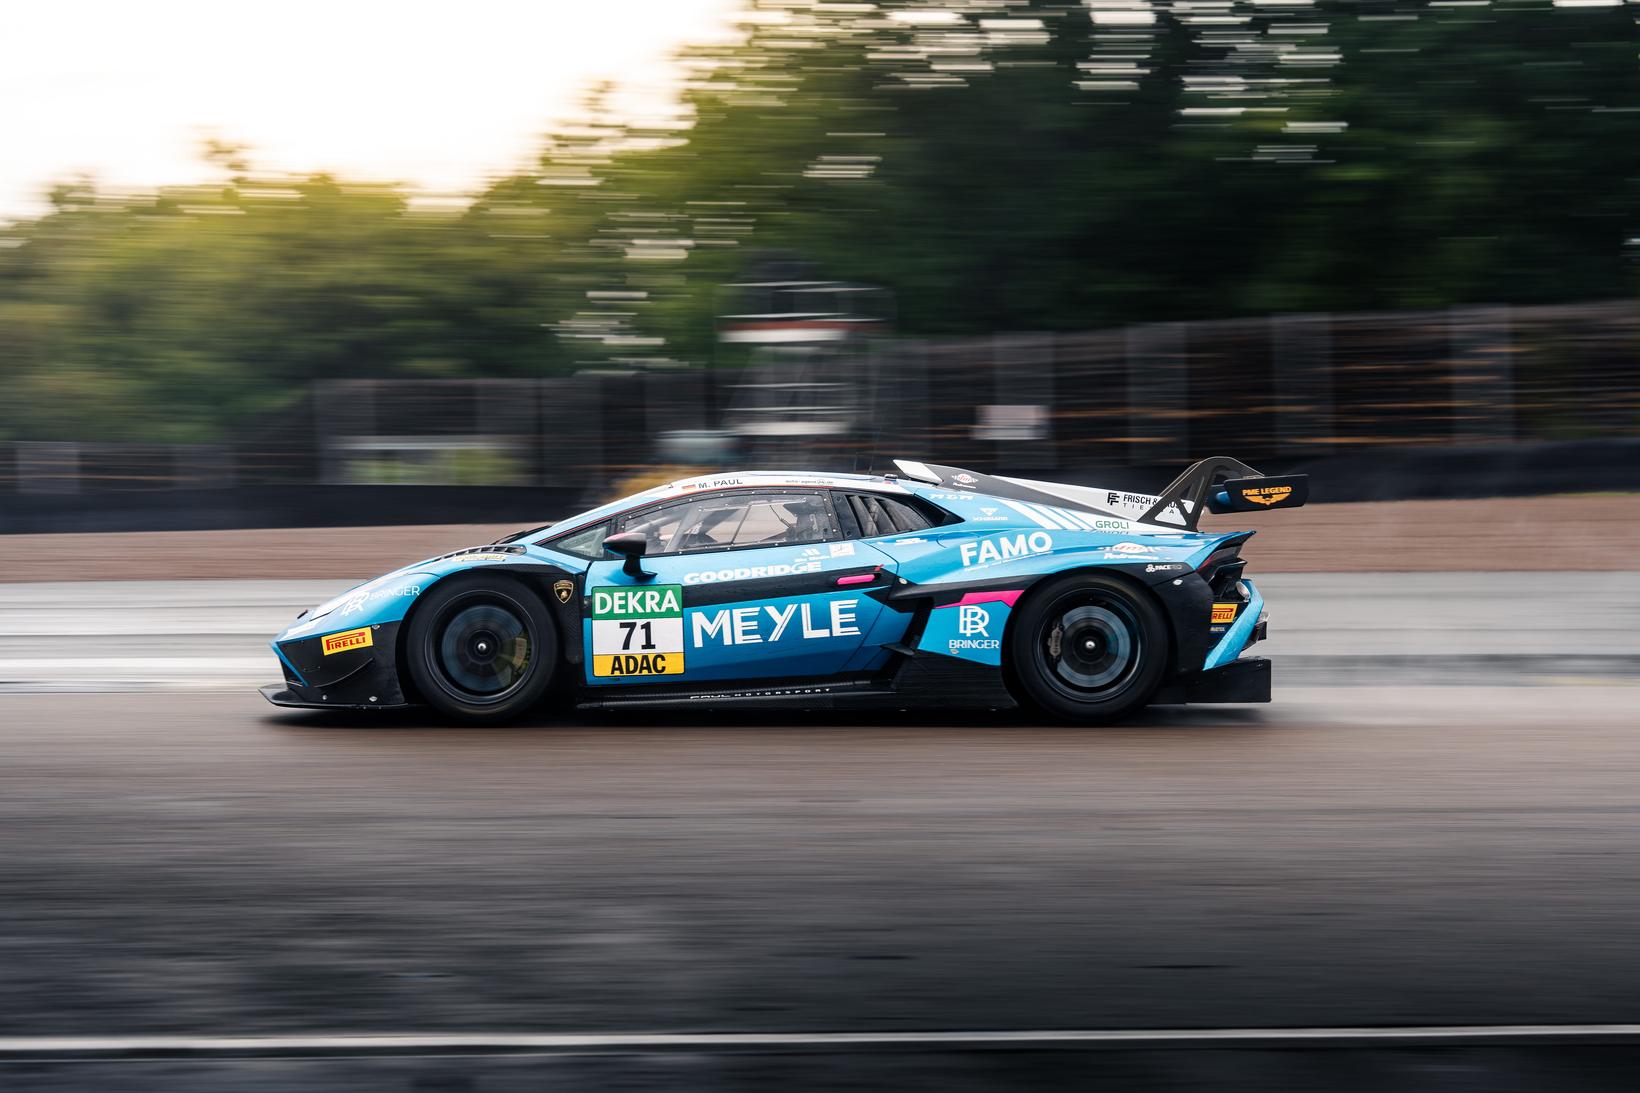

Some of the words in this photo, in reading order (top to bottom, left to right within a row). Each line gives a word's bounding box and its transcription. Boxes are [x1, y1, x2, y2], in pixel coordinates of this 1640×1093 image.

[713, 479, 743, 487] PAUL
[1242, 488, 1260, 496] PME
[1260, 486, 1292, 495] LEGEND
[1123, 494, 1151, 505] FRISCH
[1095, 520, 1129, 529] GROLI
[960, 531, 1053, 567] FAMO
[683, 561, 822, 585] GOODRIDGE
[594, 590, 680, 614] DEKRA
[691, 599, 862, 648] MEYLE
[326, 632, 366, 651] PIRELLI
[619, 621, 656, 650] 71
[948, 639, 1000, 649] BRINGER
[610, 655, 666, 675] ADAC
